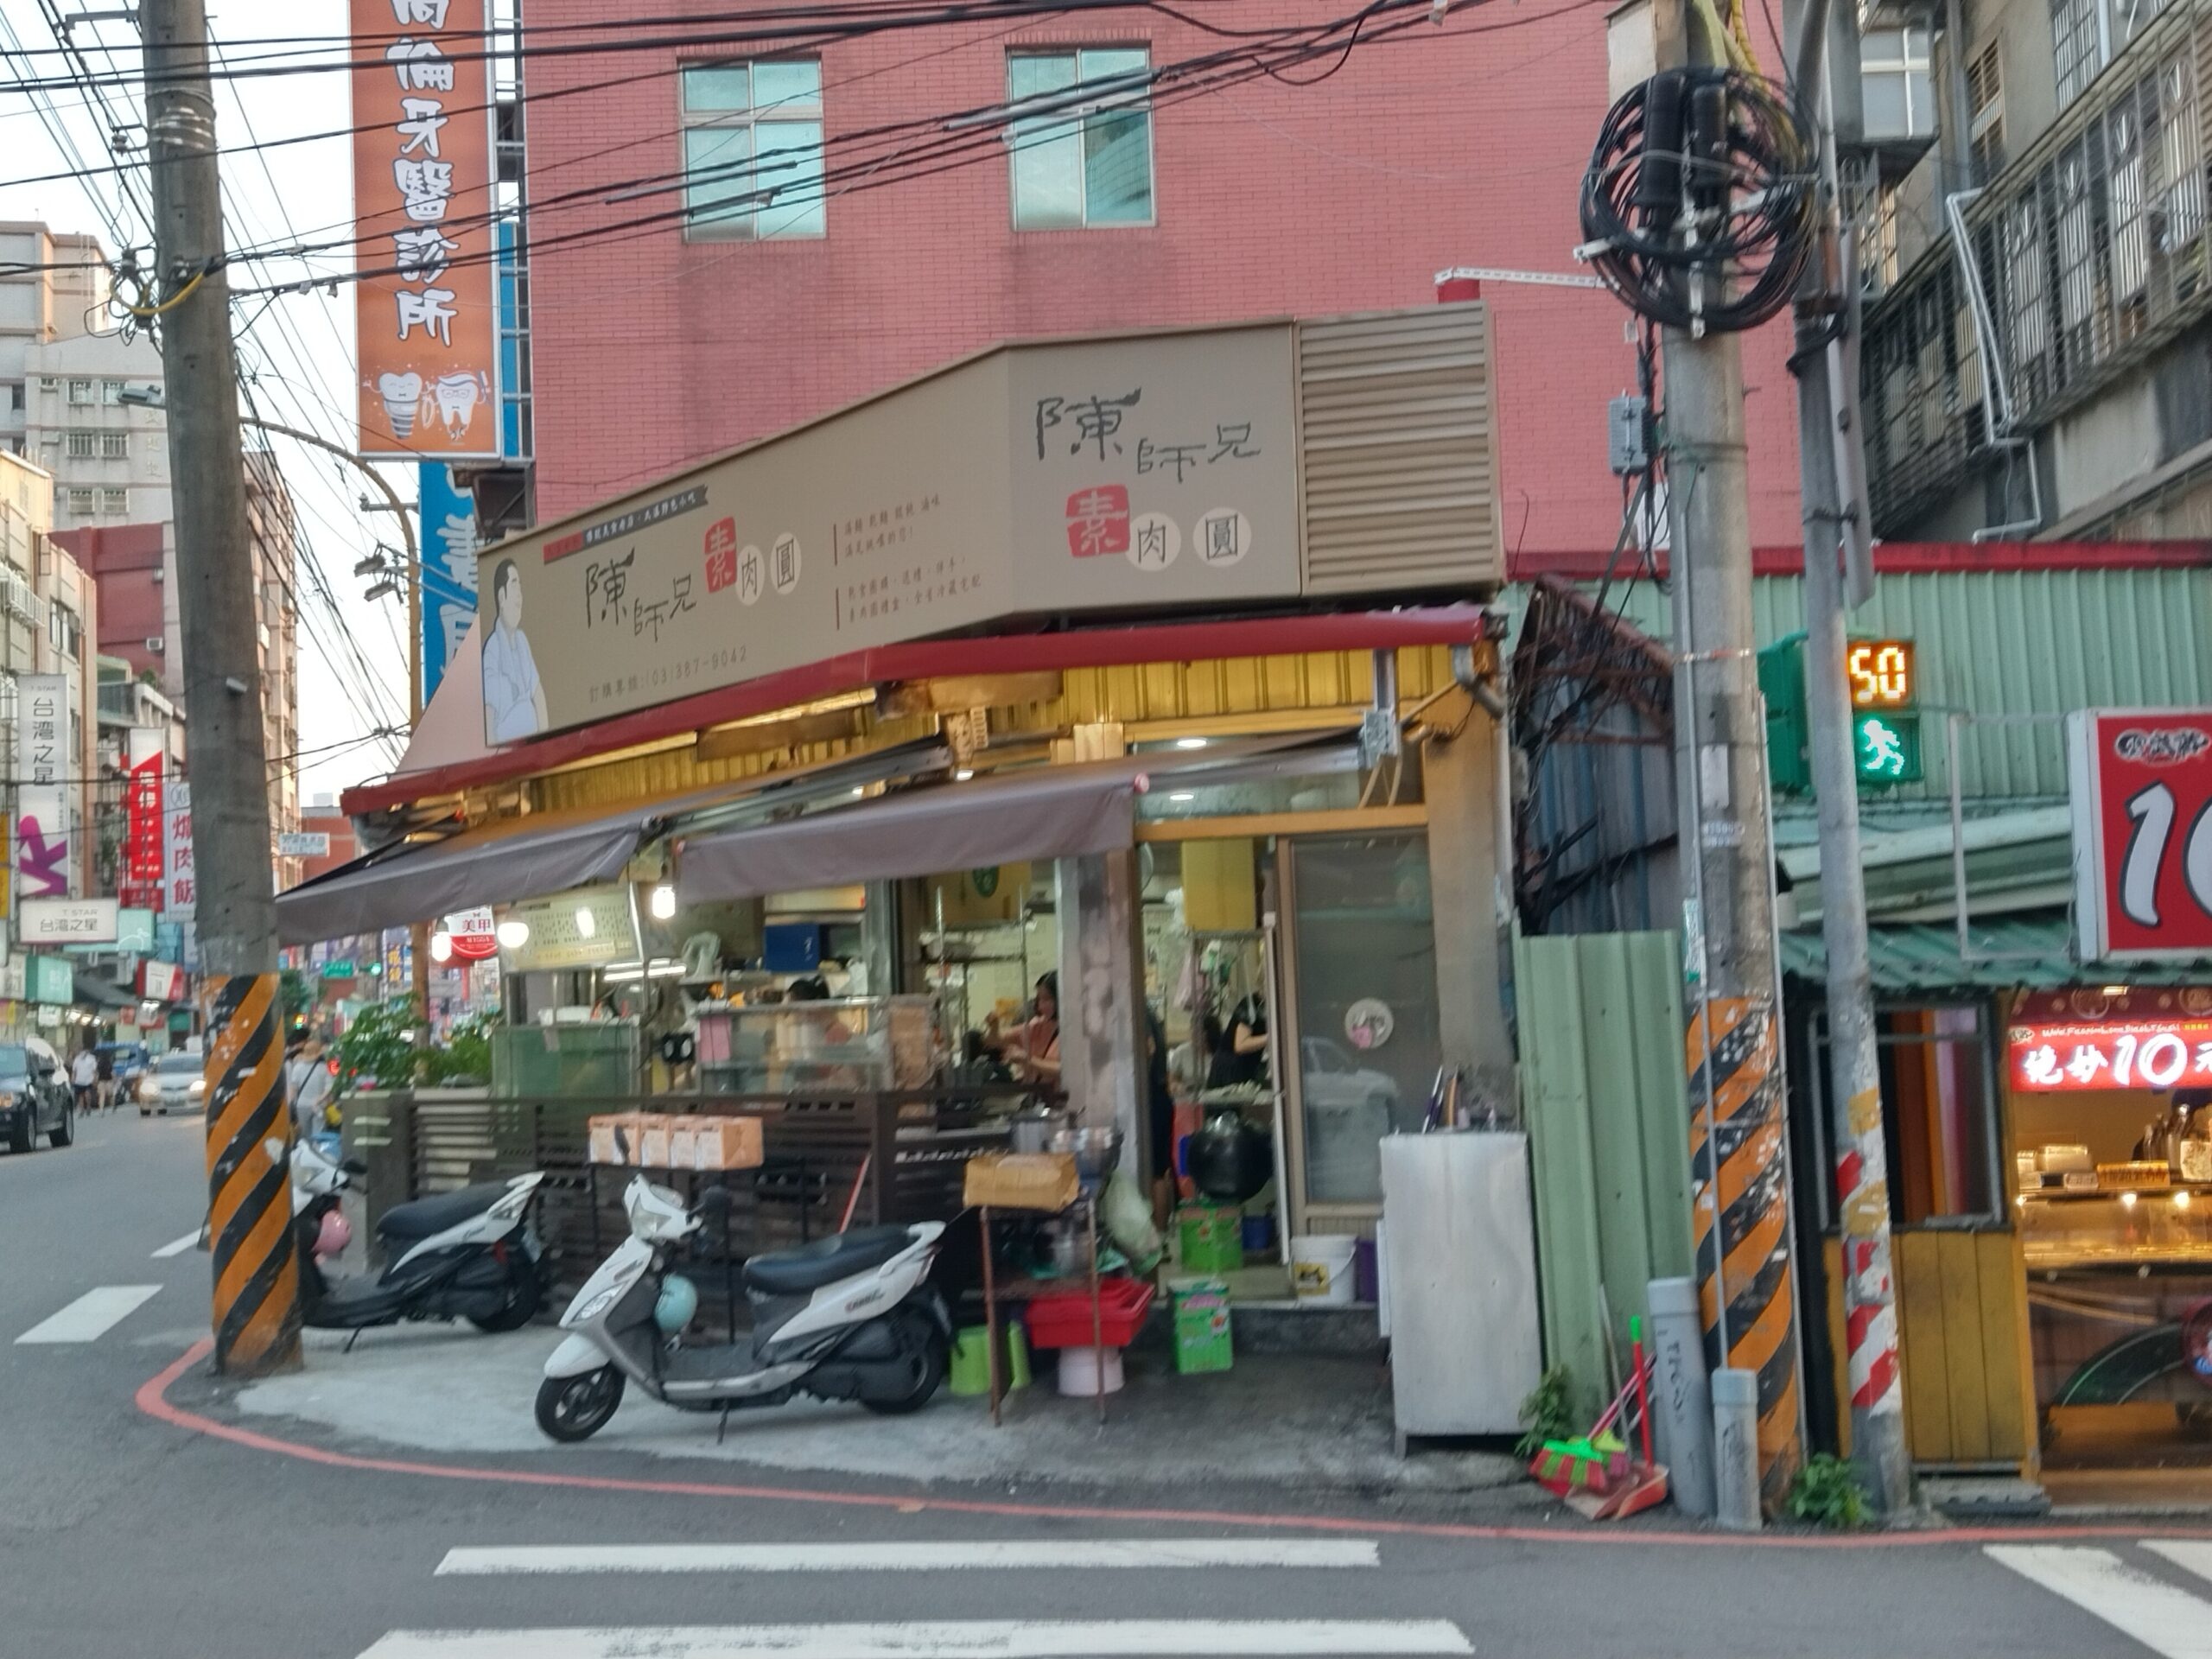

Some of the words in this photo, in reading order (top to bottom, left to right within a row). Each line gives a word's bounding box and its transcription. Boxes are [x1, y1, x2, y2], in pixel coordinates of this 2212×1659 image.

[1036, 387, 1261, 483] 陳師兄
[707, 520, 796, 601] 素肉圓
[1067, 488, 1239, 564] 素肉圓
[585, 547, 697, 643] 陳師兄
[1850, 646, 1906, 702] 50
[462, 918, 491, 933] 美甲
